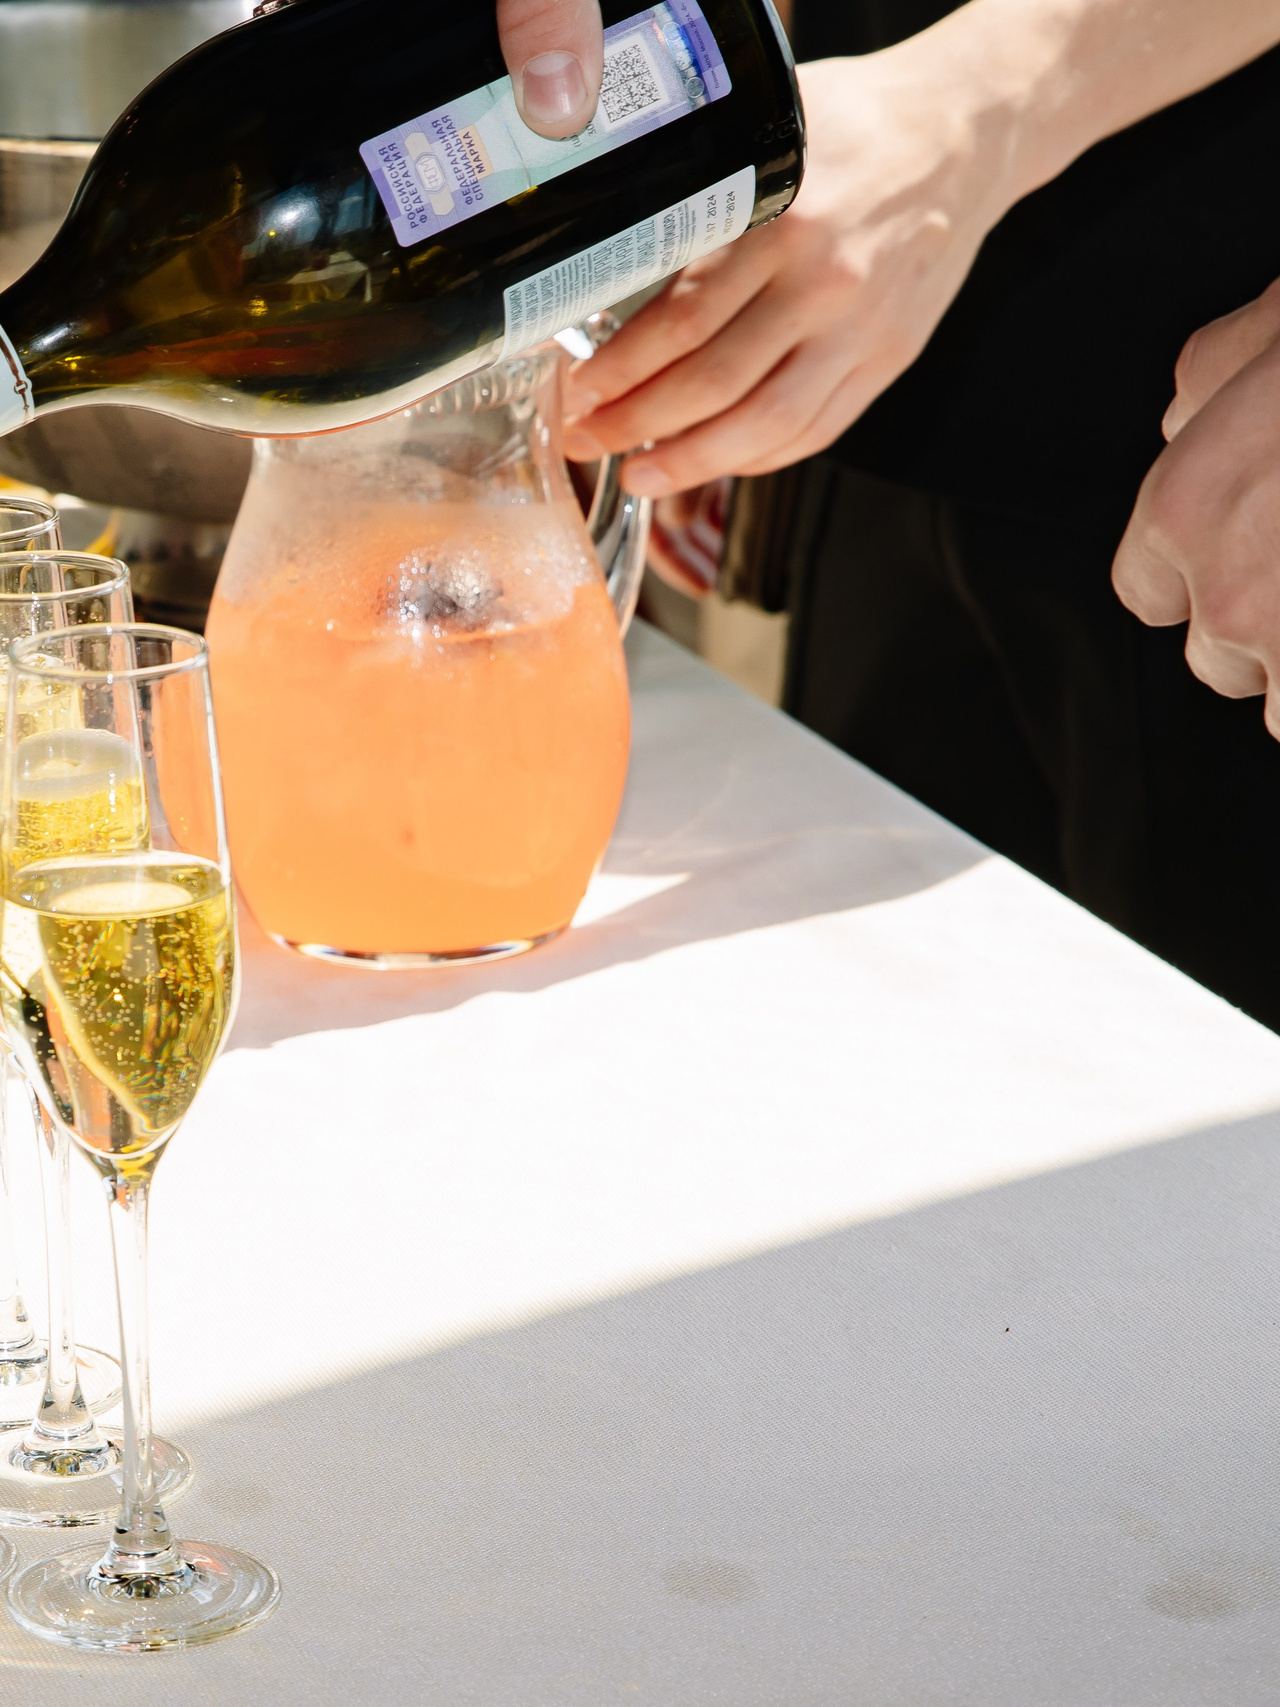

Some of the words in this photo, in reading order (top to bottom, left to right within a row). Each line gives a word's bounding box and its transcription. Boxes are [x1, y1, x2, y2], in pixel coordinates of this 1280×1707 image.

[378, 146, 419, 229] РОССИЙСКАЯ
[388, 142, 428, 224] ФЕДЕРАЦИЯ
[431, 119, 473, 205] ФЕДЕРАЛЬНАЯ
[441, 114, 484, 201] СПЕЦИАЛЬНАЯ
[463, 131, 486, 174] МАРКА
[635, 219, 655, 243] 2022
